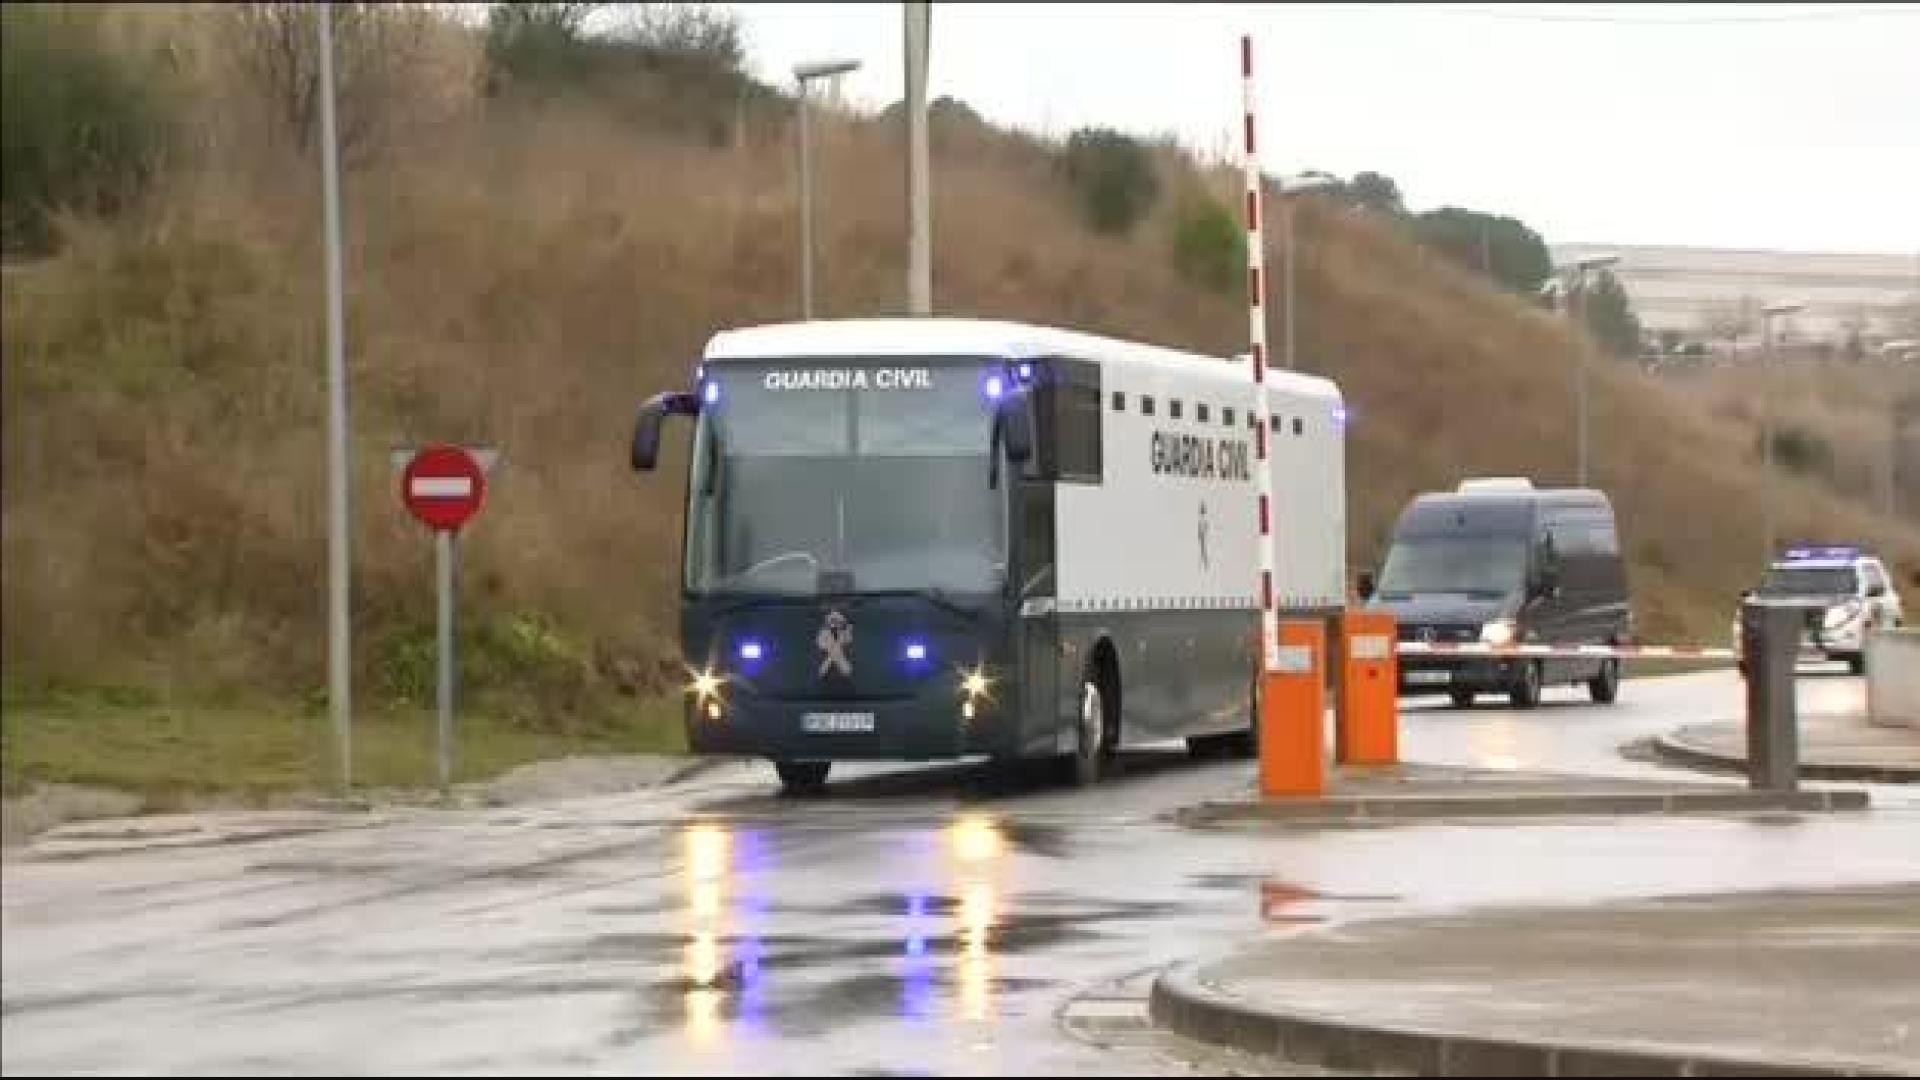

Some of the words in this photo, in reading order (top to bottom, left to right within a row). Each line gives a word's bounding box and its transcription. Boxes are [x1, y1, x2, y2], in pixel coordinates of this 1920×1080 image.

[765, 370, 868, 390] GUARDIA
[877, 369, 932, 389] CIVIL
[1151, 430, 1214, 477] GUARDIA
[1218, 439, 1250, 480] CIVIL
